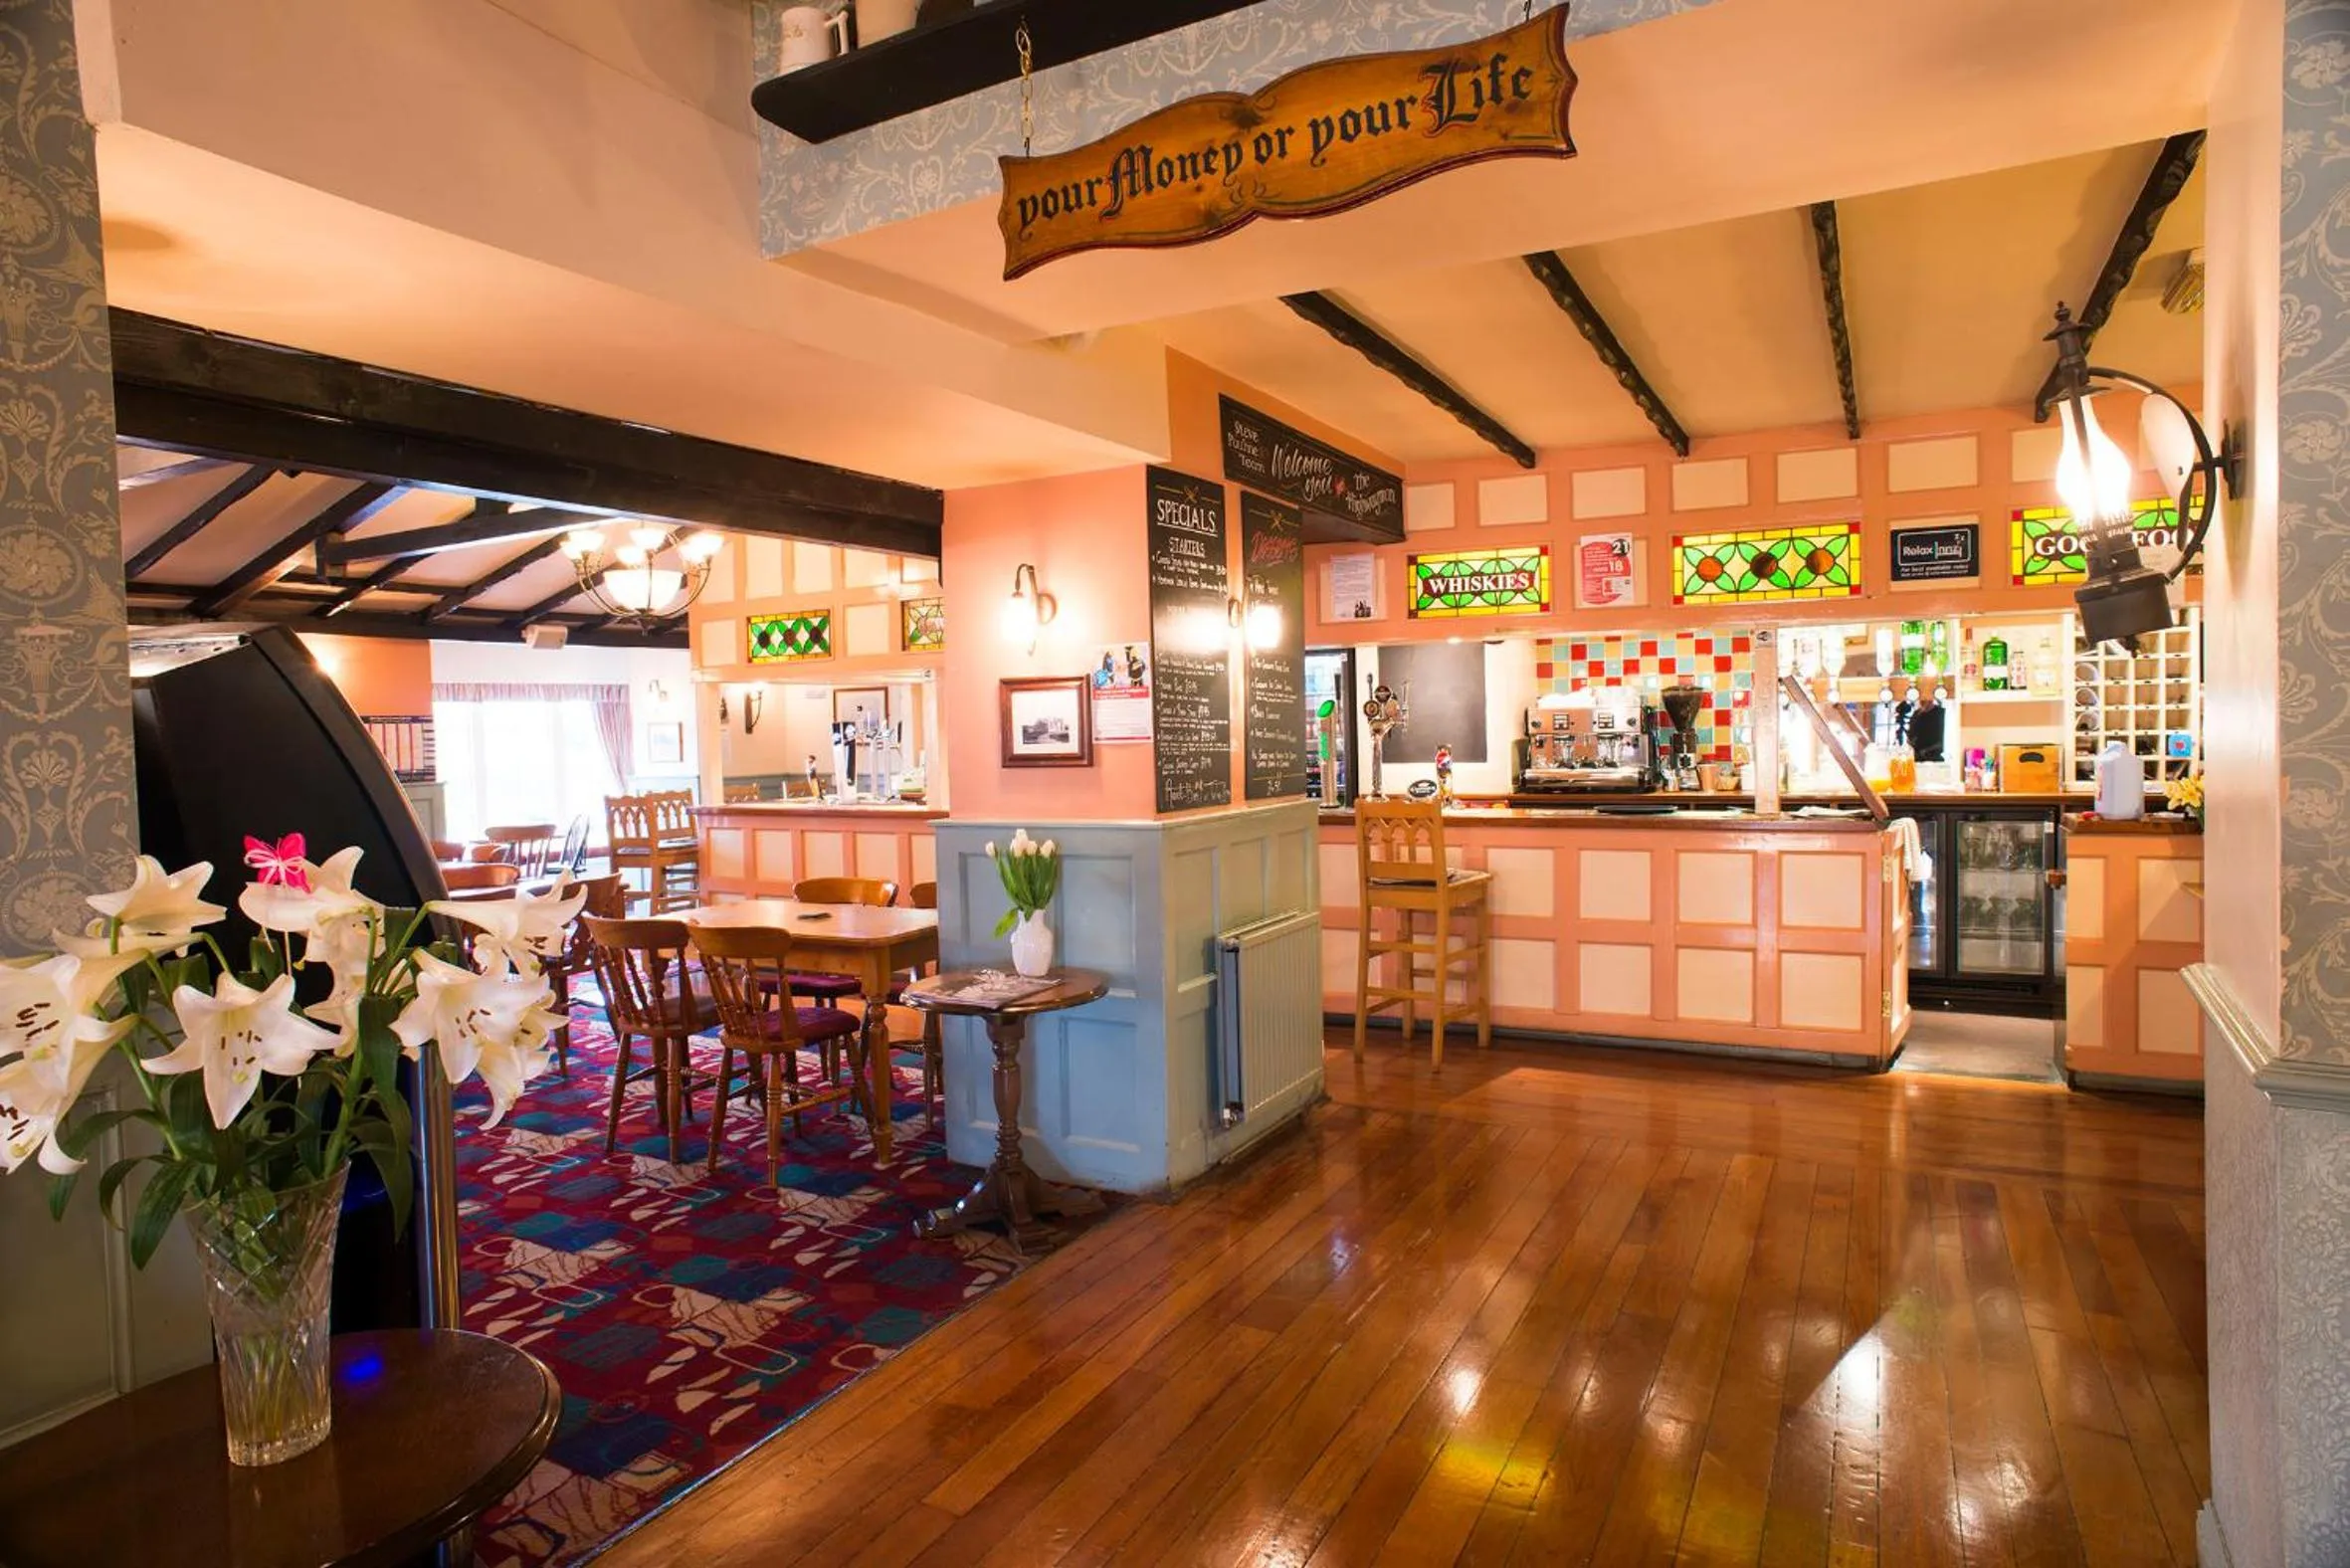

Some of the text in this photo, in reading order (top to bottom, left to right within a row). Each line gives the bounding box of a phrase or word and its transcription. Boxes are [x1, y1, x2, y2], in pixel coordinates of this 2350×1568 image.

[1017, 51, 1532, 243] your Money or your Life
[1235, 420, 1260, 444] Steve
[1239, 453, 1266, 475] Team
[1272, 443, 1334, 481] Welcome
[1303, 475, 1334, 502] you
[1353, 472, 1371, 491] the
[1157, 498, 1218, 533] SPECIALS
[1612, 540, 1630, 553] 21
[1902, 545, 1933, 556] Relax
[2035, 533, 2094, 556] GOO
[1609, 559, 1624, 573] 18
[1428, 572, 1530, 594] WHISKIES
